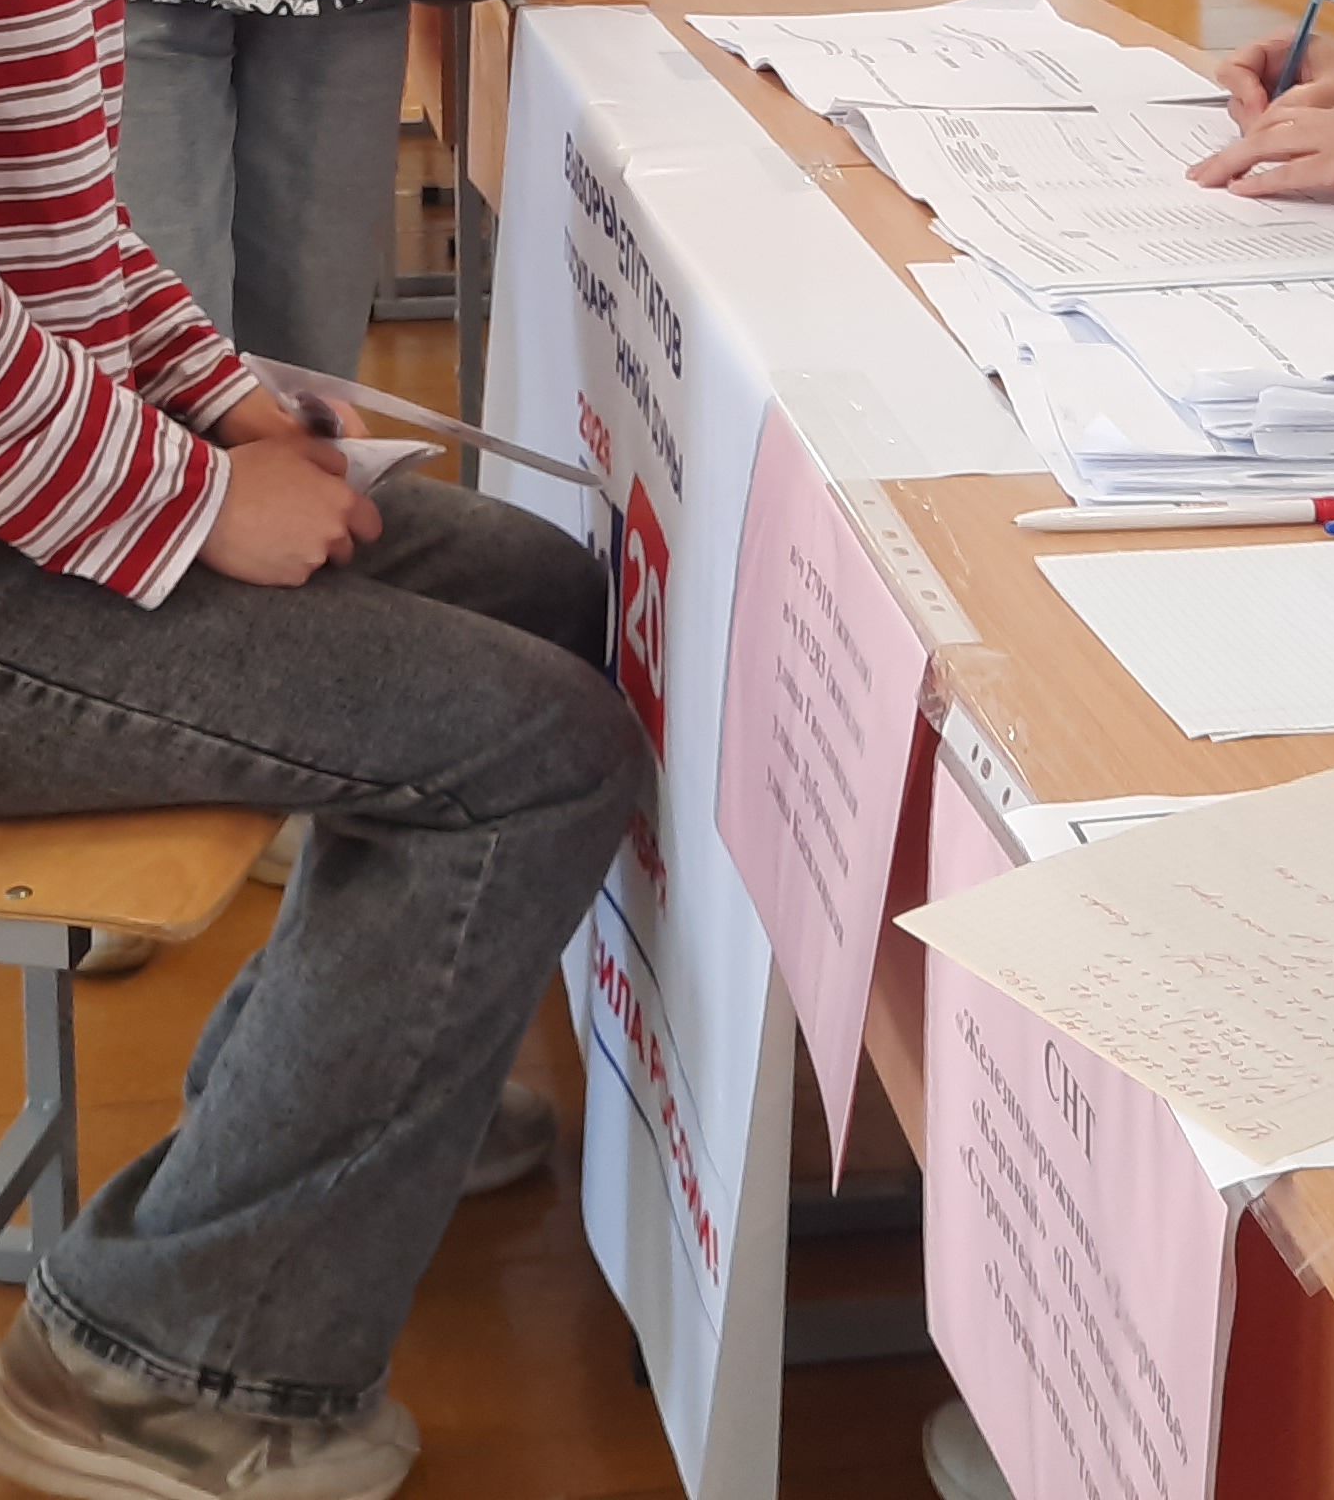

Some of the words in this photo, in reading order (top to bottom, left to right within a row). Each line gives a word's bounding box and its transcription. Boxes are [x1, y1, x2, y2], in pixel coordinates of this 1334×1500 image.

[564, 132, 618, 245] ВЫБОРЫ
[625, 529, 665, 700] 20
[1043, 1037, 1097, 1164] СНТ
